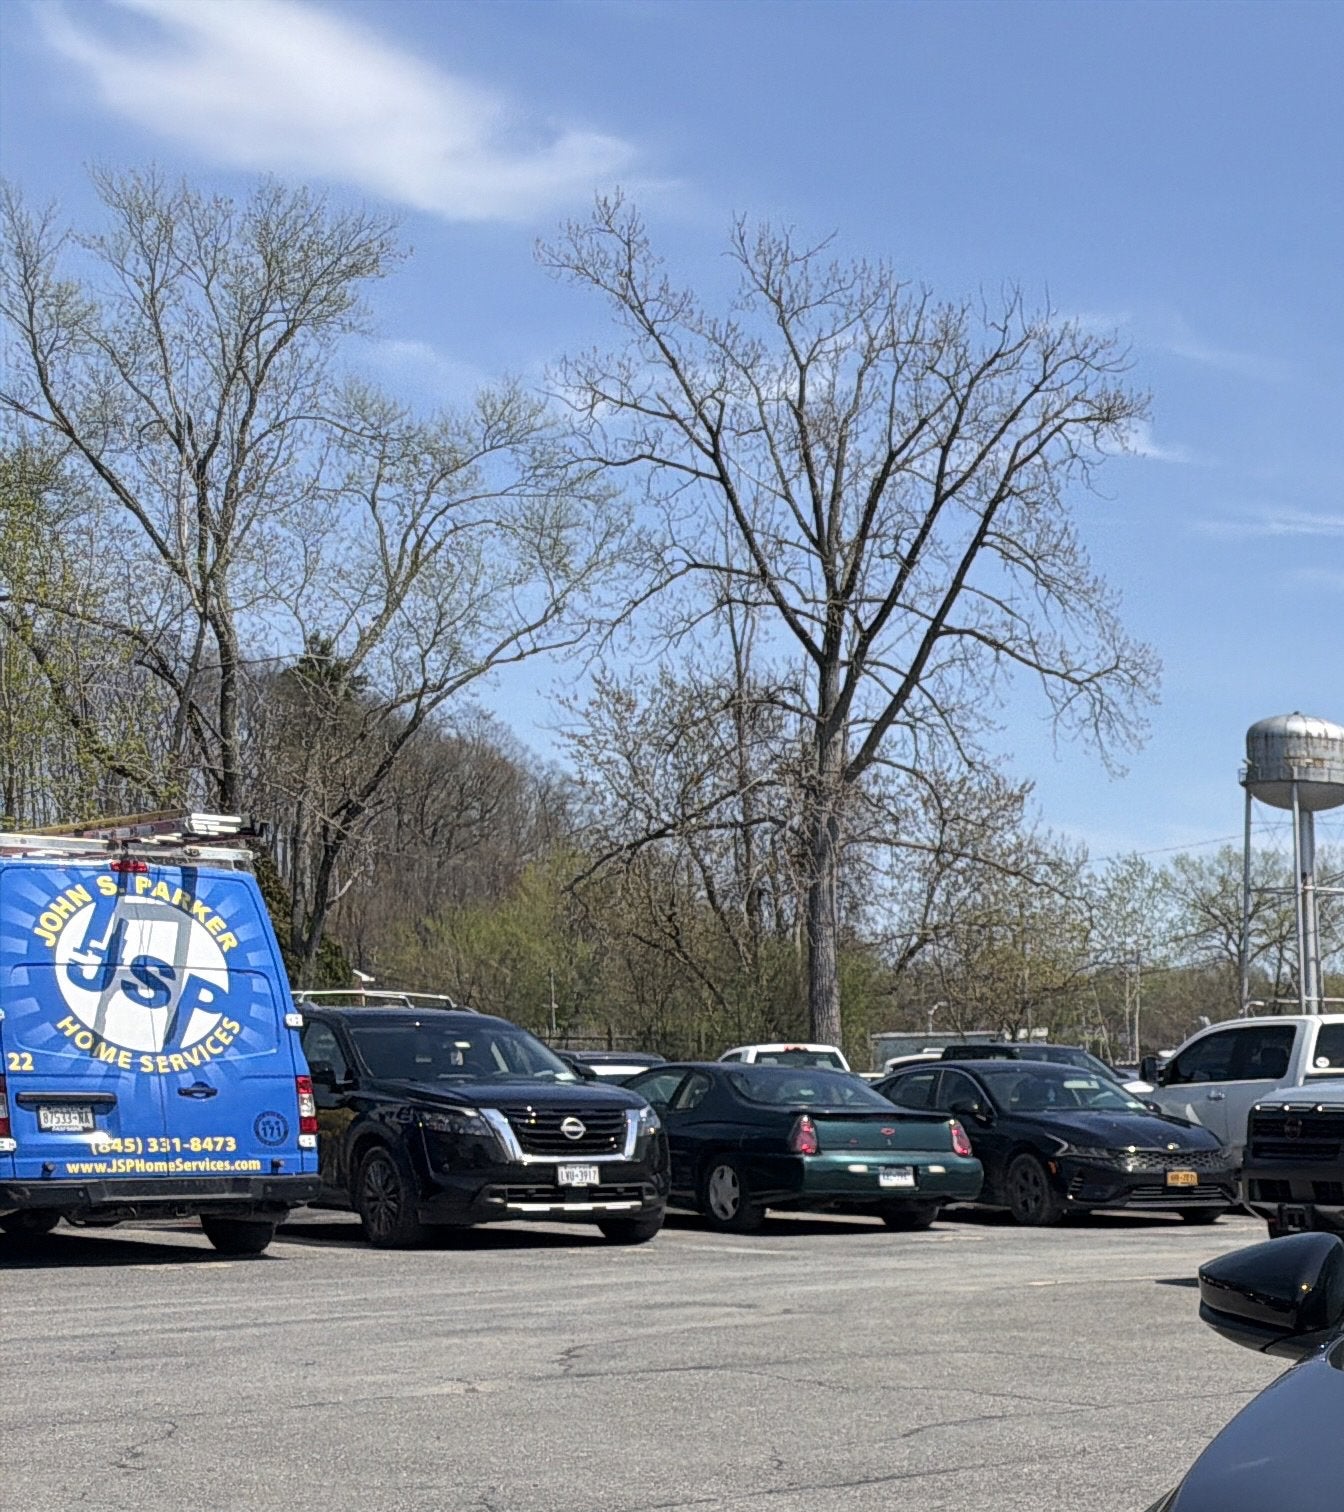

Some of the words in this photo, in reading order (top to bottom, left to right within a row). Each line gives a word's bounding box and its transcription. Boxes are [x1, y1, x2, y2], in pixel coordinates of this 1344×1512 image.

[34, 883, 93, 947] JOHN
[96, 875, 126, 896] S.
[135, 876, 239, 953] PARKER
[56, 1015, 133, 1070] HOME
[140, 1016, 241, 1073] SERVICES
[8, 1053, 35, 1071] 22
[147, 1136, 237, 1152] 331-8473
[66, 1157, 262, 1174] www.JSPHomeServices.com
